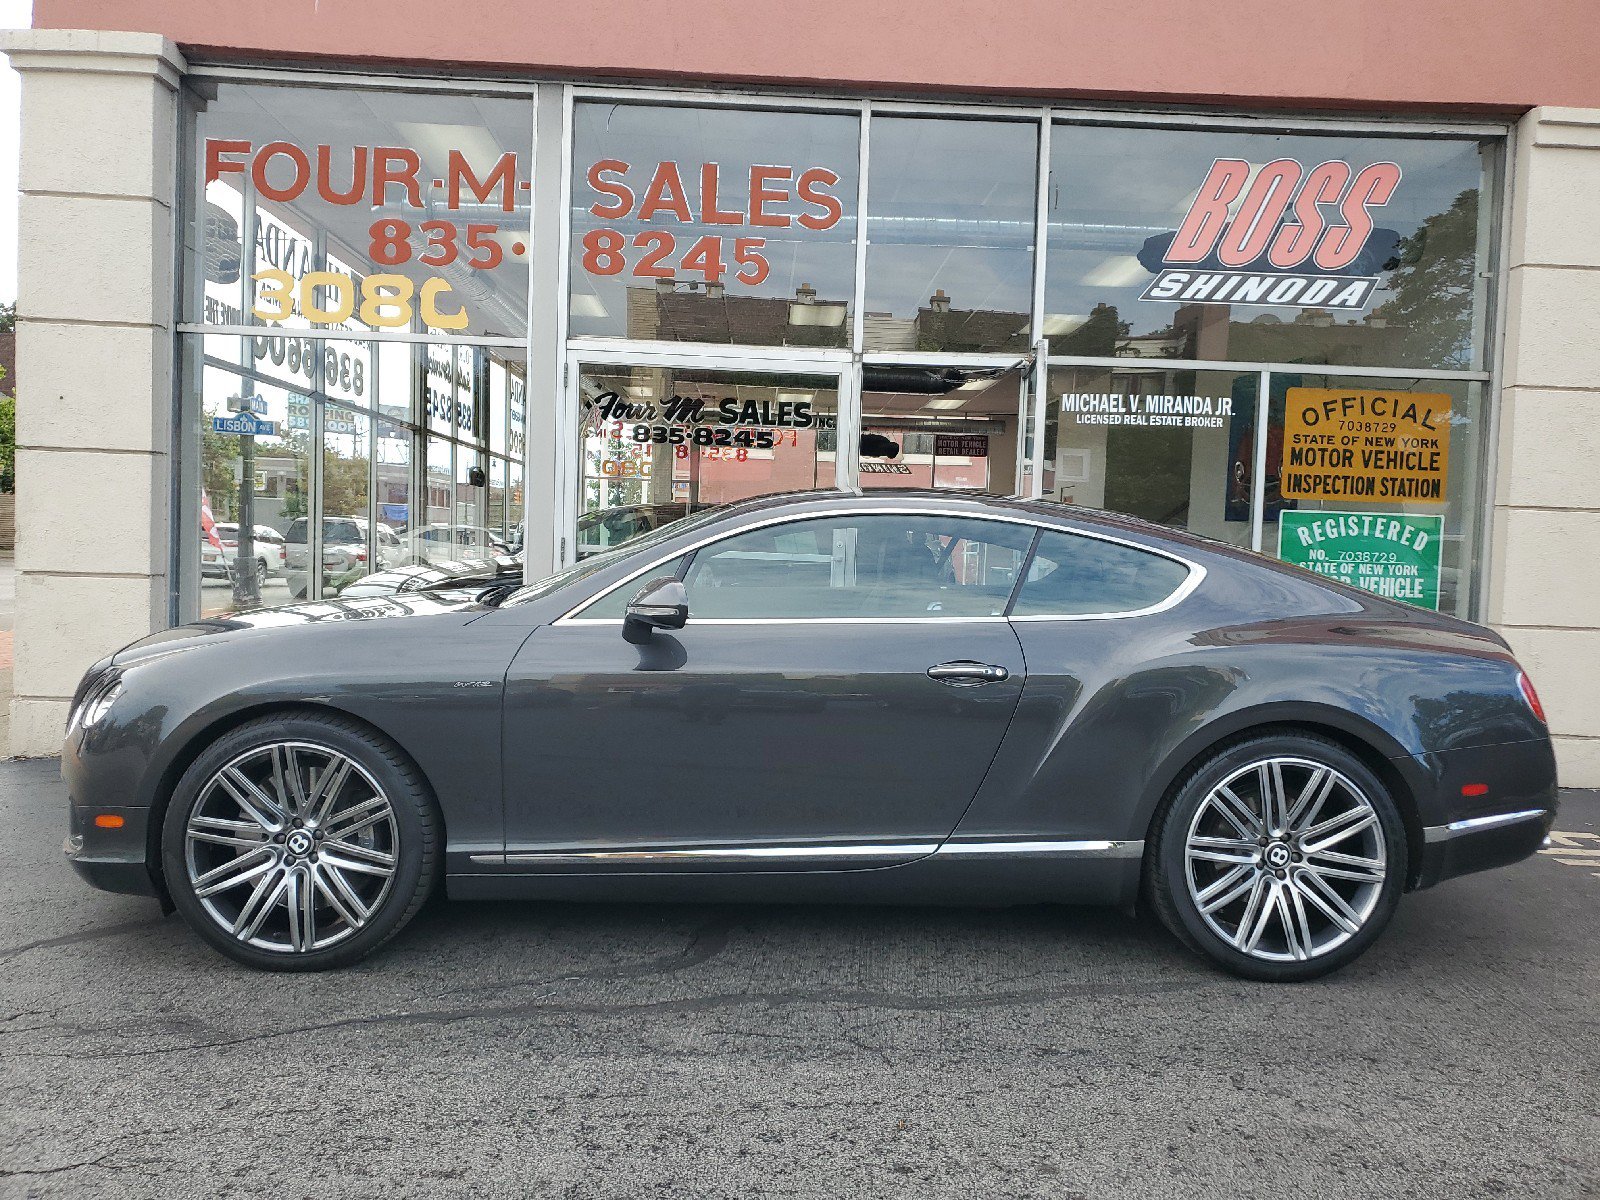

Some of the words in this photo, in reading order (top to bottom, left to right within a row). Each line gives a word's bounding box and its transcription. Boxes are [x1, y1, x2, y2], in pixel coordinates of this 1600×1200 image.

[586, 158, 843, 231] SALES
[1162, 157, 1402, 270] BOSS
[581, 228, 770, 286] 8245
[1149, 272, 1370, 306] SHINODA
[660, 394, 704, 423] M
[718, 397, 814, 428] SALES
[1061, 393, 1126, 413] MICHAEL
[1129, 394, 1141, 413] V.
[1146, 395, 1212, 415] MIRANDA
[1215, 397, 1236, 416] JR.
[1302, 396, 1437, 431] OFFICIAL
[216, 419, 256, 432] LISBON
[1076, 414, 1121, 425] LICENSED
[1124, 415, 1148, 426] REAL
[1150, 415, 1183, 427] ESTATE
[1185, 416, 1223, 428] BROKER
[1339, 420, 1397, 432] 7038729
[1293, 433, 1335, 445] STATE
[1341, 436, 1359, 445] OF
[1365, 436, 1396, 447] NEW
[1401, 437, 1439, 449] YORK
[1290, 447, 1354, 468] MOTOR
[1361, 449, 1441, 471] VEHICLE
[1287, 473, 1375, 496] INSPECTION
[1379, 476, 1441, 498] STATION
[1297, 515, 1428, 551] REGISTERED
[1309, 549, 1329, 561] NO.
[1338, 551, 1397, 562] 7038729
[1339, 563, 1355, 574] OF
[1358, 564, 1384, 575] NEW
[1388, 564, 1418, 576] YORK
[1359, 576, 1424, 598] VEHICLE
